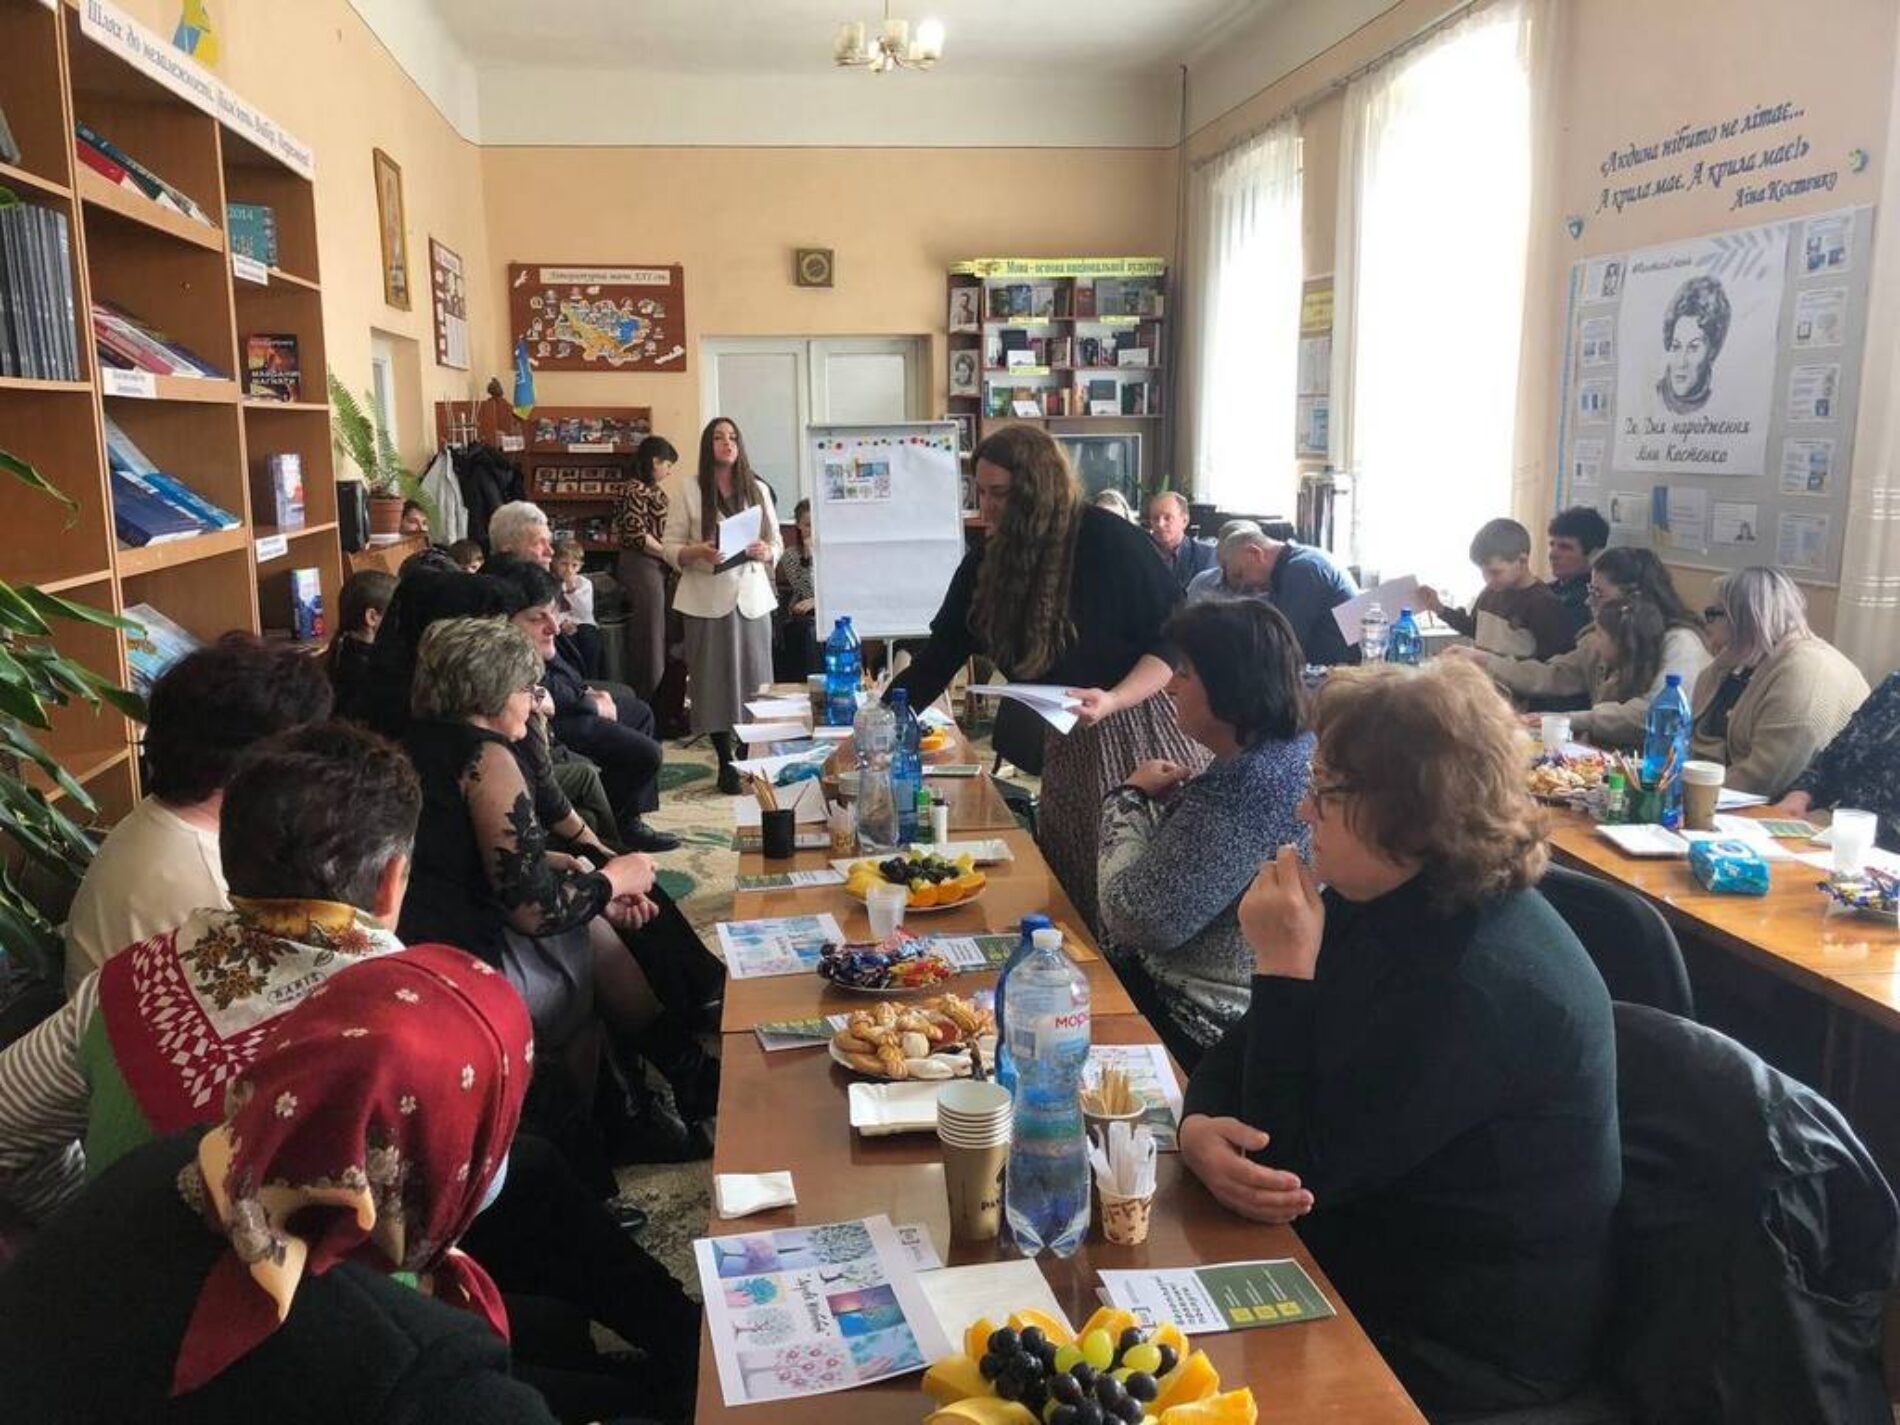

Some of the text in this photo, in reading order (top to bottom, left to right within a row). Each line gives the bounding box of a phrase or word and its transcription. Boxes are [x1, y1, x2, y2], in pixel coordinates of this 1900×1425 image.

[1662, 124, 1717, 157] нібито
[1720, 119, 1739, 139] не
[1612, 182, 1652, 214] крила
[1686, 161, 1704, 192] А
[1708, 153, 1757, 189] крила
[1729, 171, 1838, 212] Ліна Костенко
[1671, 415, 1750, 443] народження
